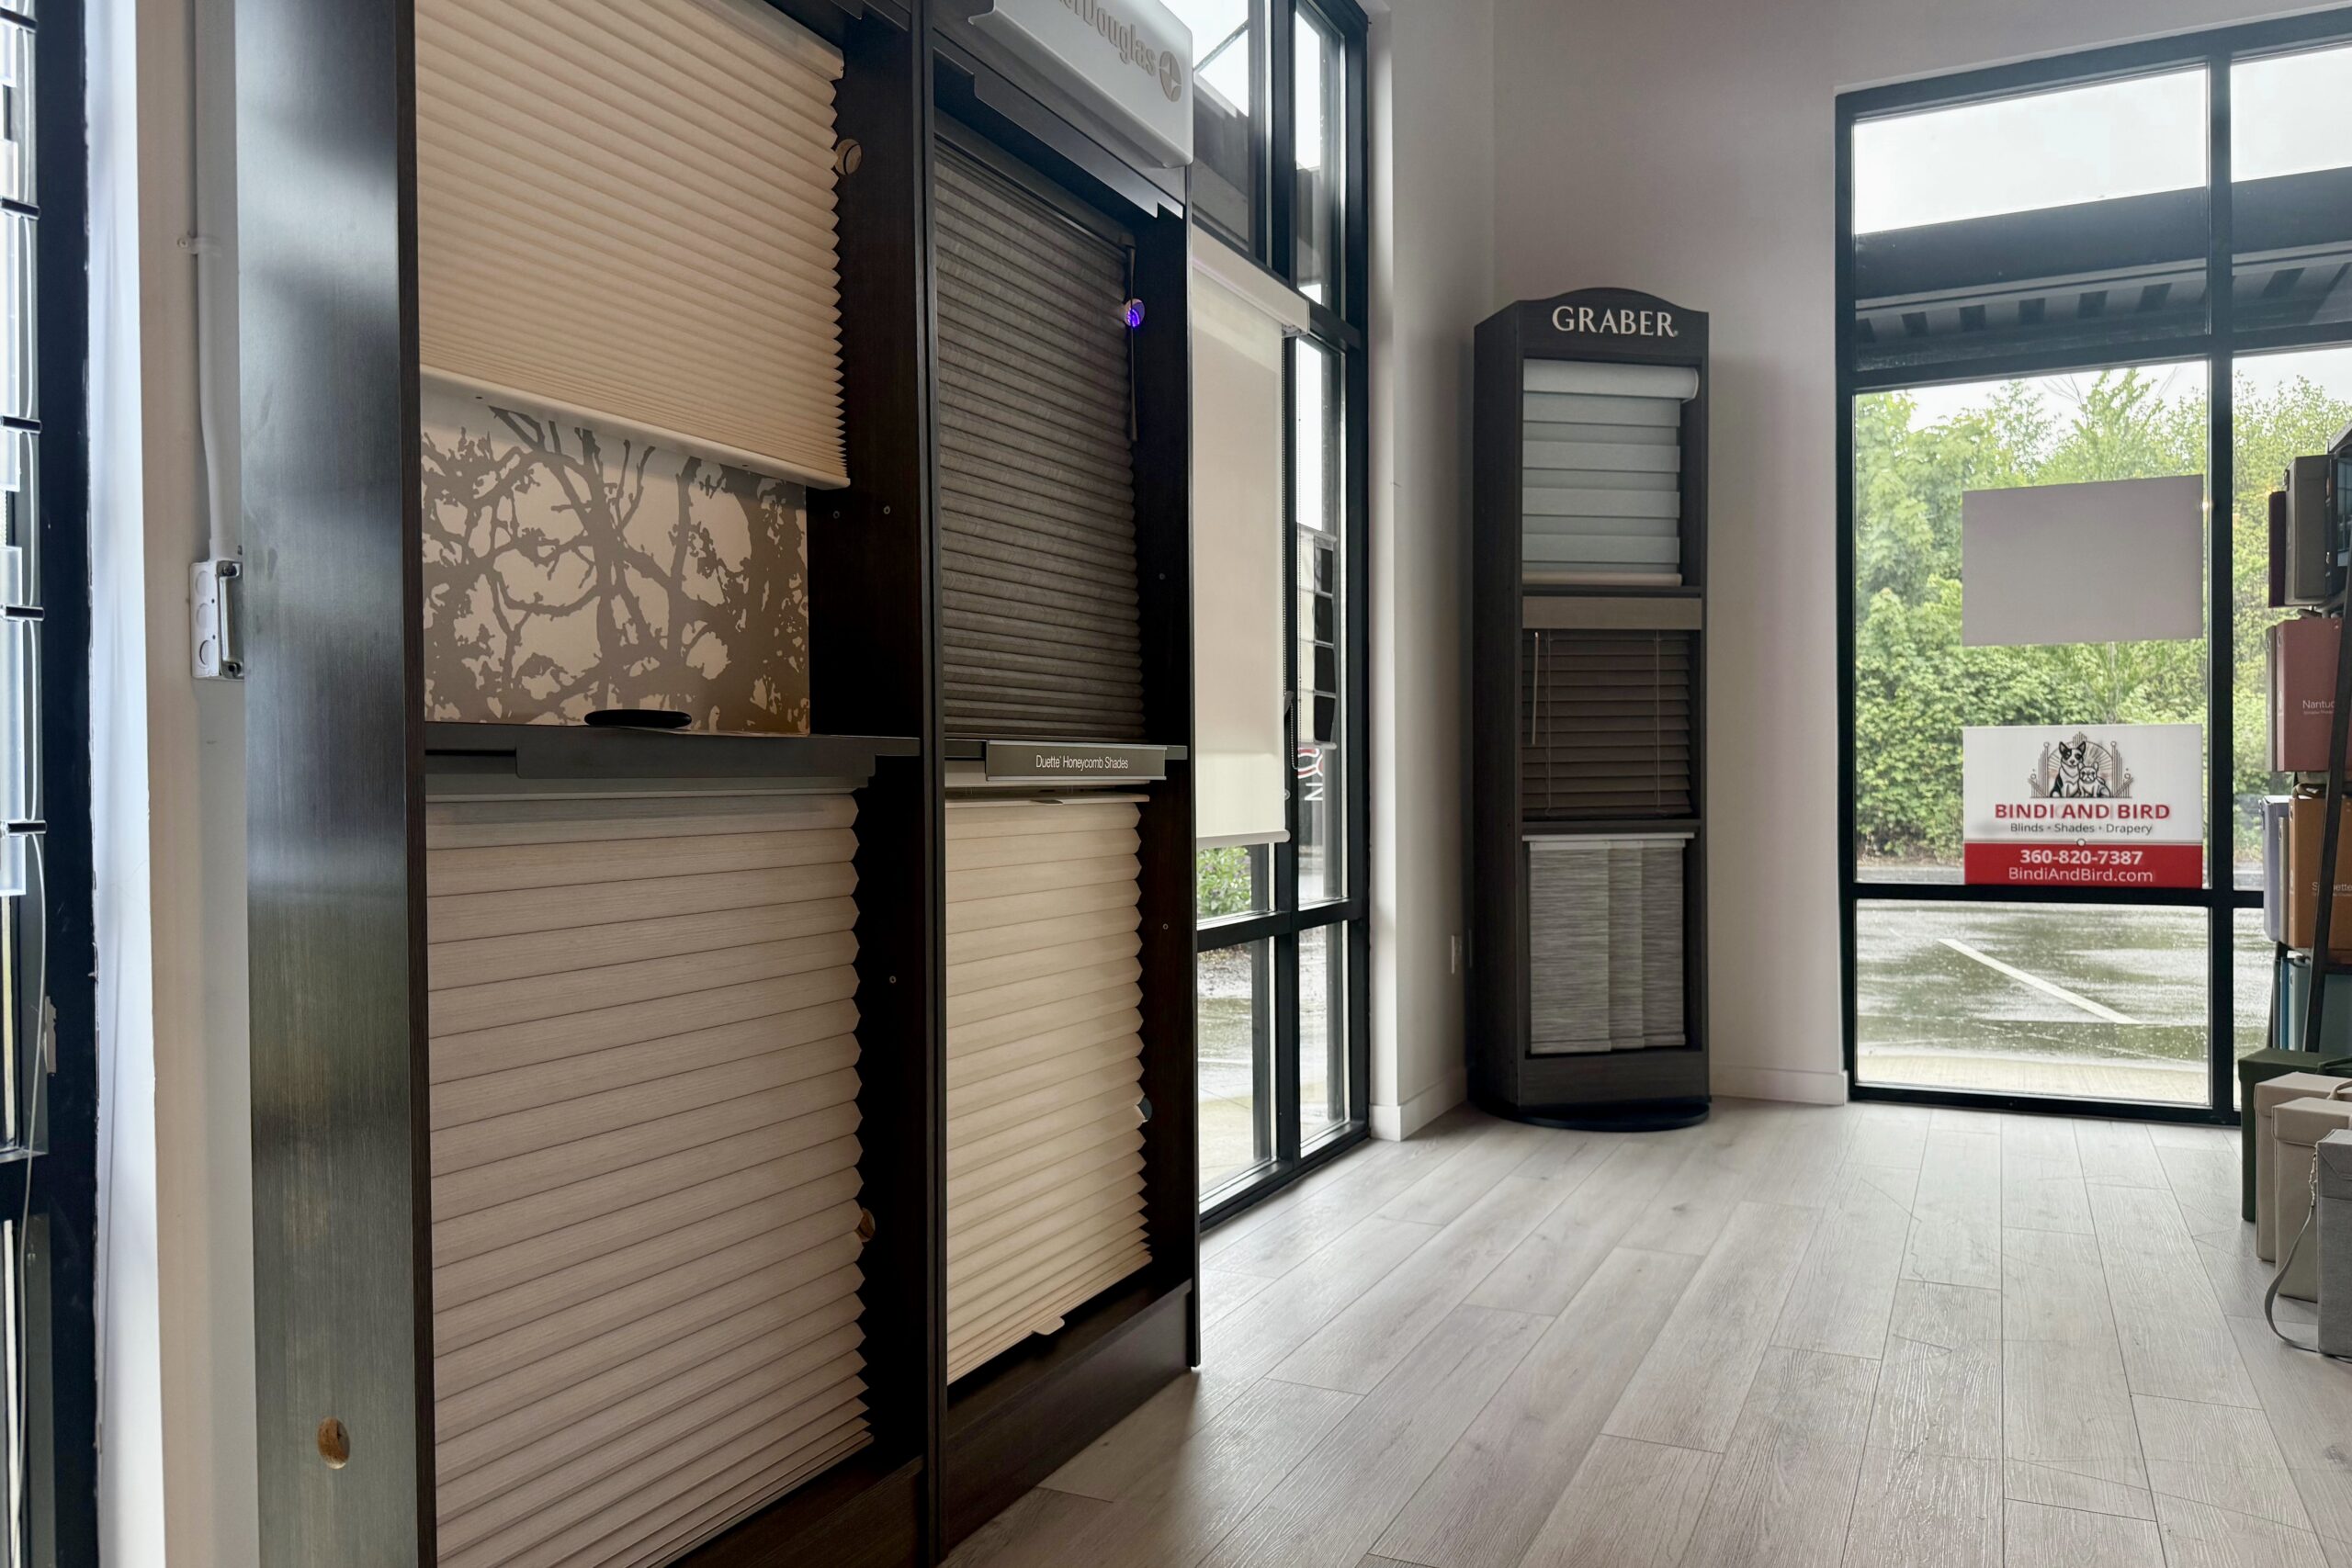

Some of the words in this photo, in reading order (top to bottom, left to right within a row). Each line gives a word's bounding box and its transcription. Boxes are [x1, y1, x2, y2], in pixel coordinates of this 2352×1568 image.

[1552, 306, 1675, 337] GRABER
[1062, 755, 1103, 771] Honeycomb
[1104, 756, 1128, 769] Shades
[1995, 804, 2054, 819] BINDI
[2061, 804, 2109, 819] AND
[2118, 804, 2170, 819] BIRD
[2010, 822, 2044, 832] Blinds
[2054, 822, 2095, 833] Shades
[2106, 823, 2153, 835] Drapery
[2019, 849, 2143, 865] 360-820-7387
[2008, 866, 2154, 882] BindiAndBird.com
